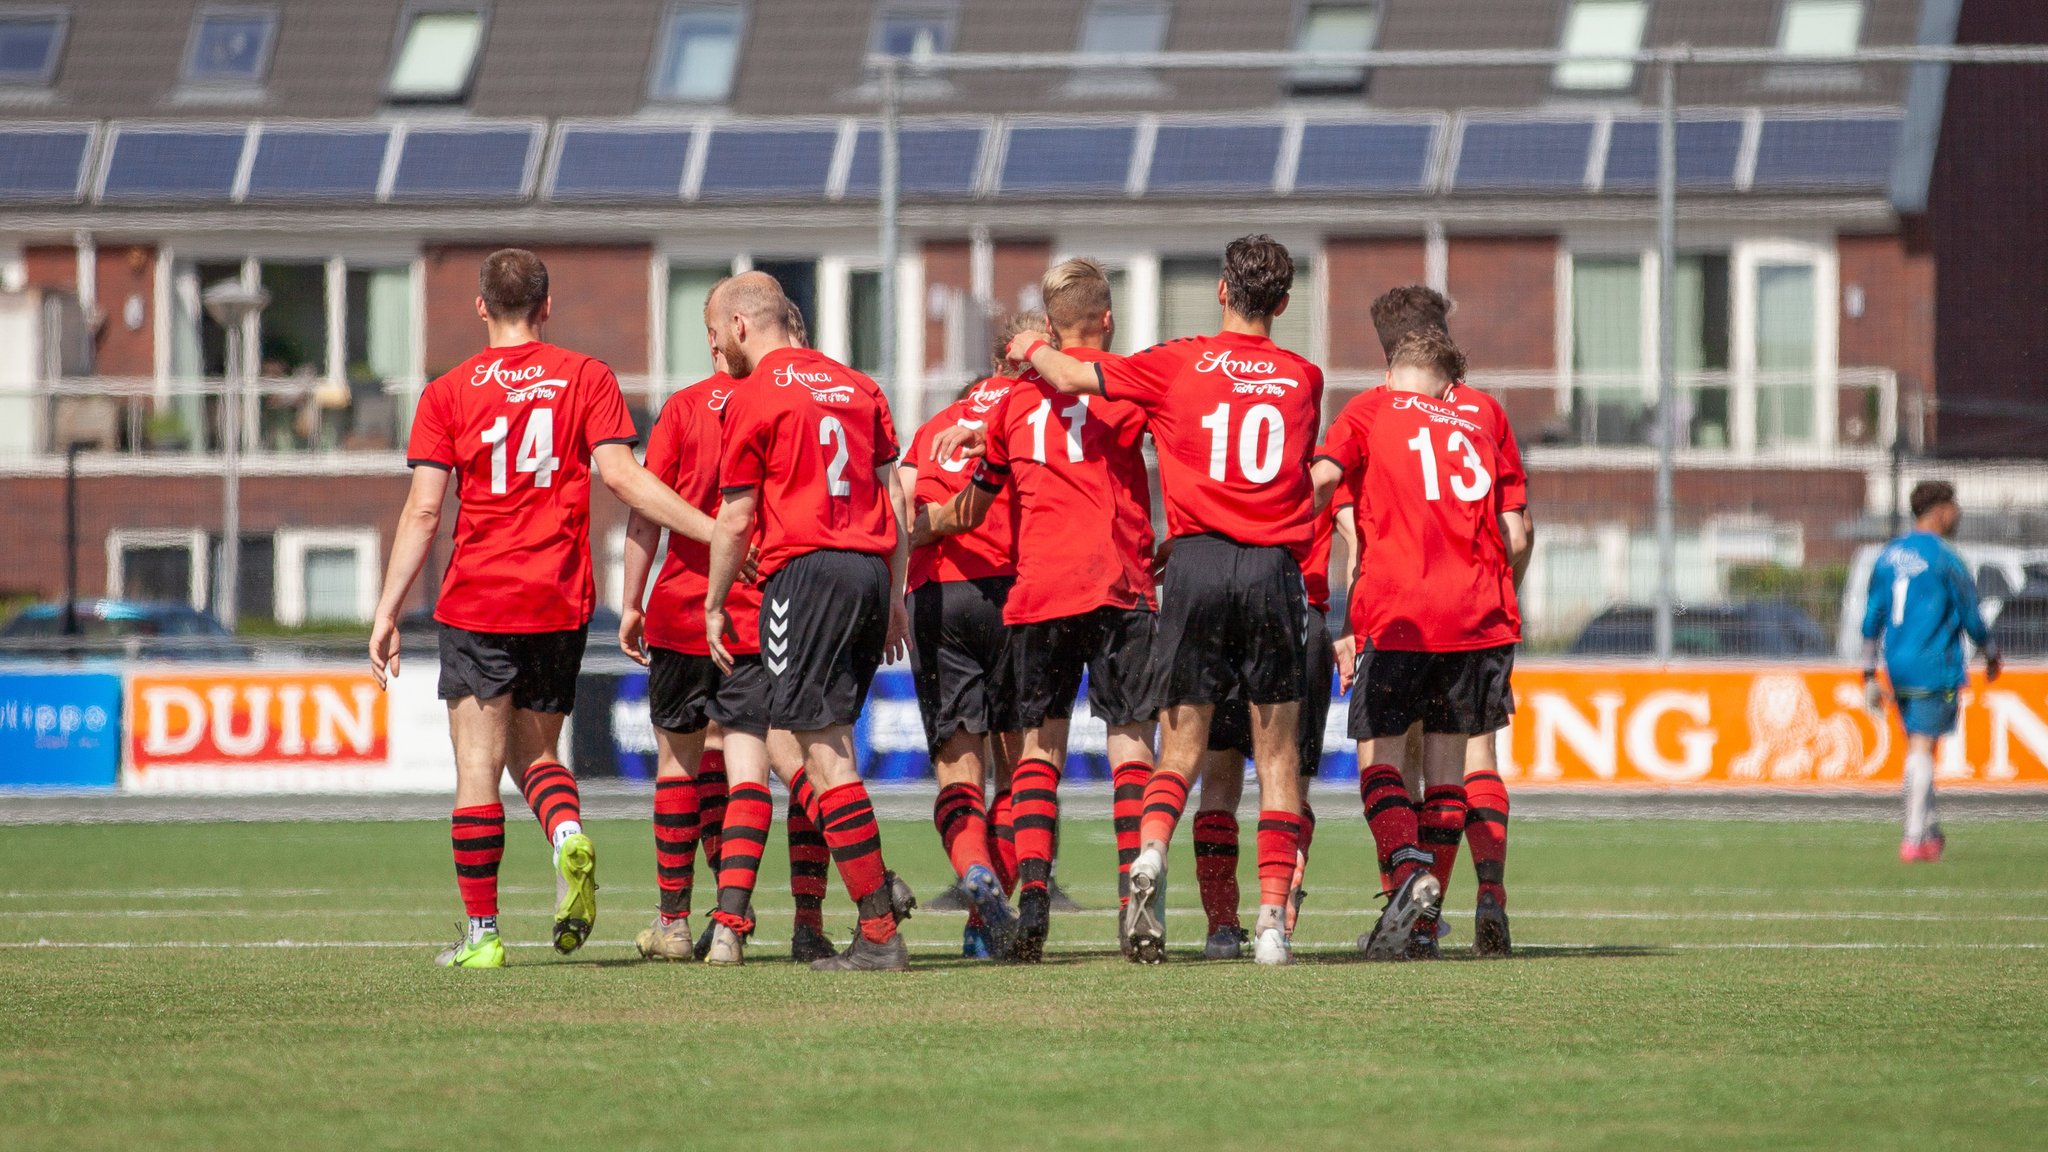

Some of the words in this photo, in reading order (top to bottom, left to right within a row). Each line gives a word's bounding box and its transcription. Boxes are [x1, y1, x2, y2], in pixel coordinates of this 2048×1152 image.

[481, 408, 560, 494] 14
[820, 415, 850, 496] 2
[1027, 395, 1090, 466] 11
[1201, 402, 1285, 484] 10
[1408, 427, 1492, 501] 13
[1891, 577, 1910, 627] 1
[142, 685, 379, 756] DUIN
